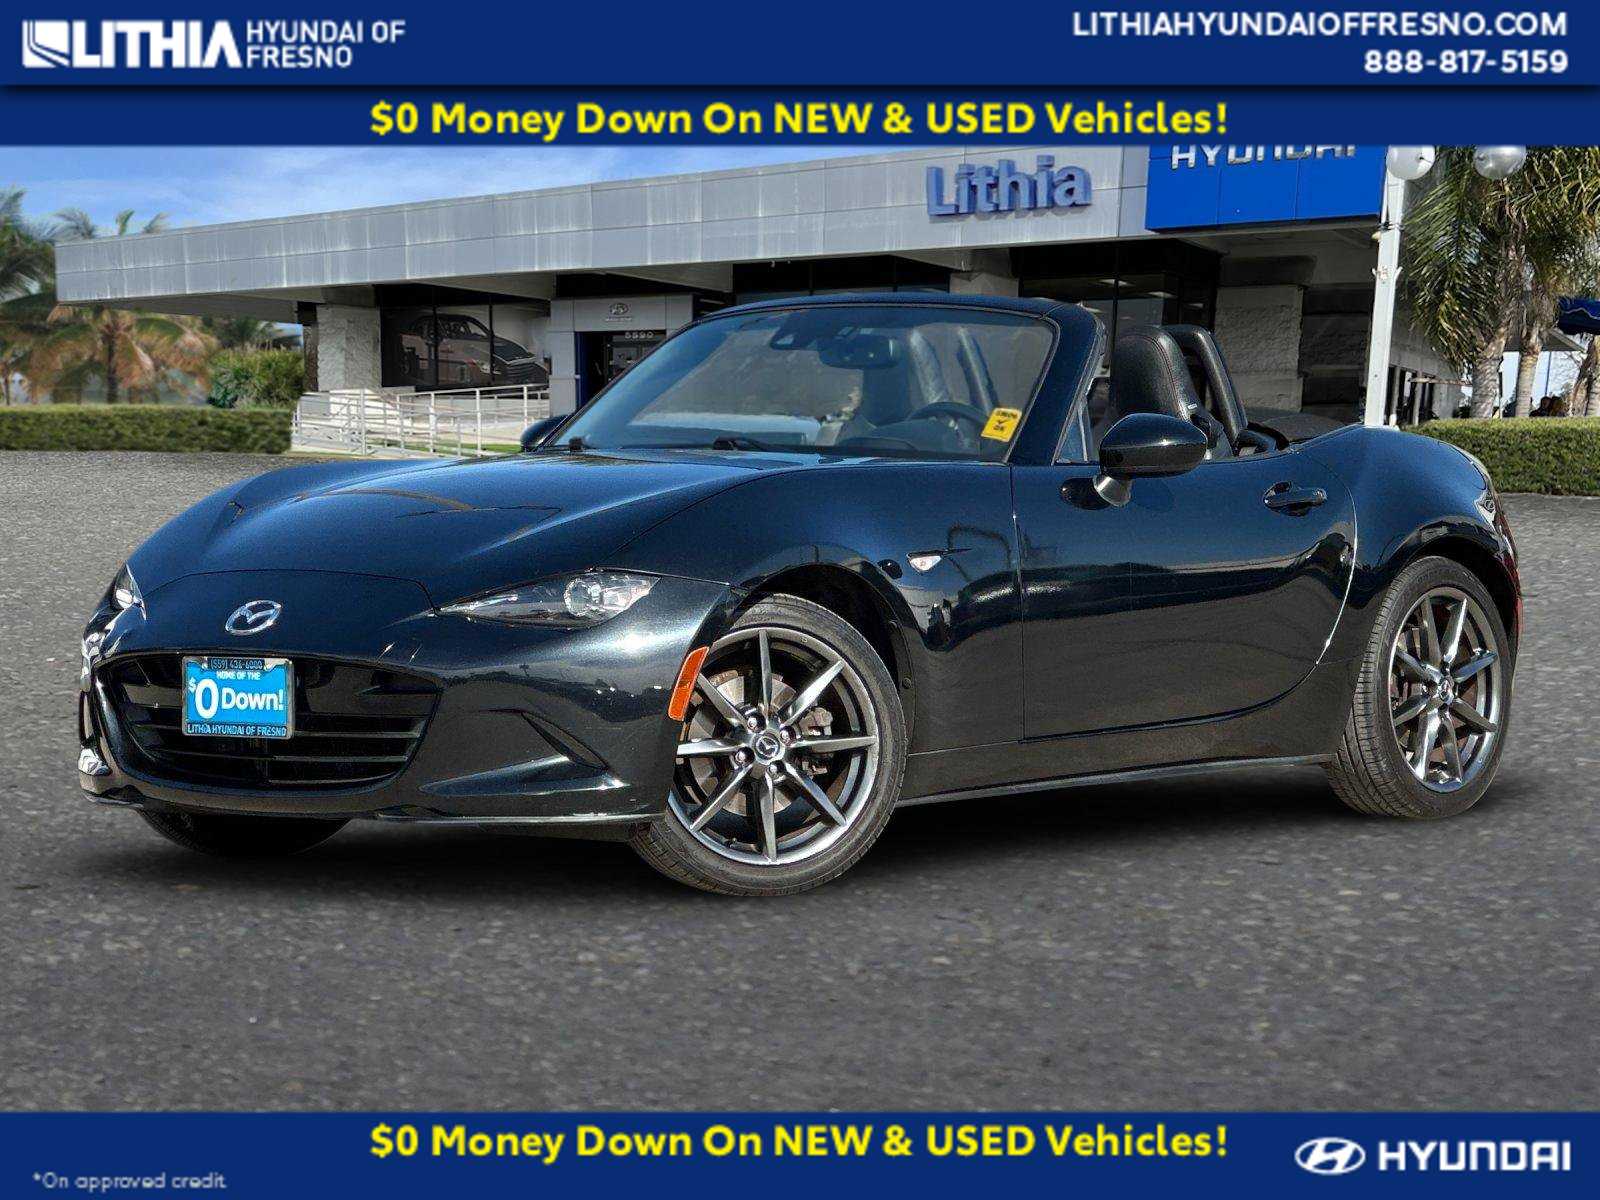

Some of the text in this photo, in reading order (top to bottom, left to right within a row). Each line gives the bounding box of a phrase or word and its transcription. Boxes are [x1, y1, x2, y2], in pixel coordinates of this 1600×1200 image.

[926, 154, 1093, 217] Lithia
[216, 670, 261, 681] HOME OF THE
[221, 687, 284, 711] Down!
[187, 723, 287, 737] LITHIA HYUNDAI OF FRESNO
